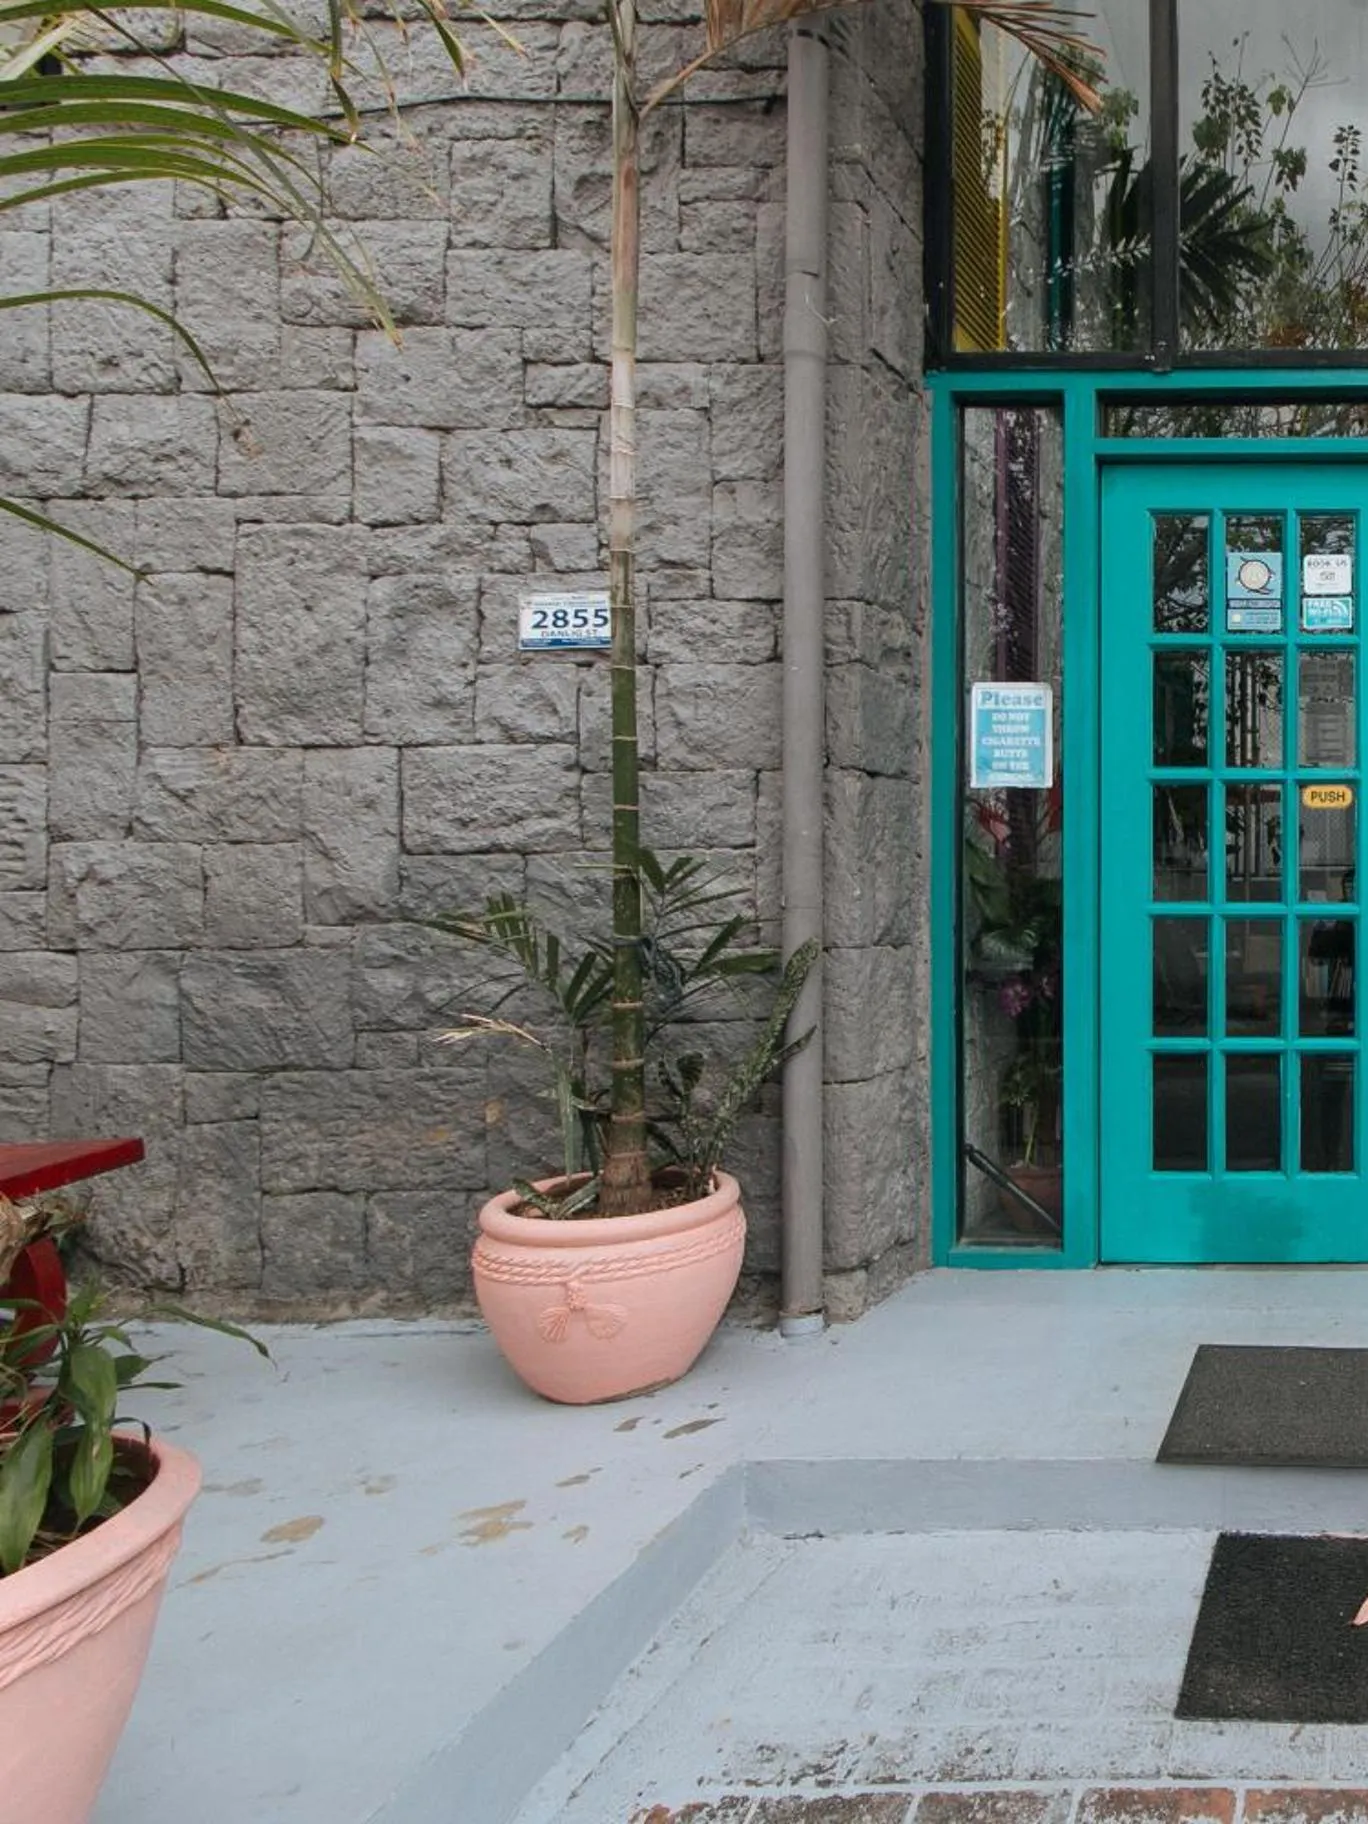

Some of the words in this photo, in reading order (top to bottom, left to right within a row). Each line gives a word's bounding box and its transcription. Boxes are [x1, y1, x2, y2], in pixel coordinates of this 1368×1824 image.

[531, 608, 609, 629] 2855
[980, 691, 1043, 706] Please
[1310, 790, 1346, 803] PUSH
